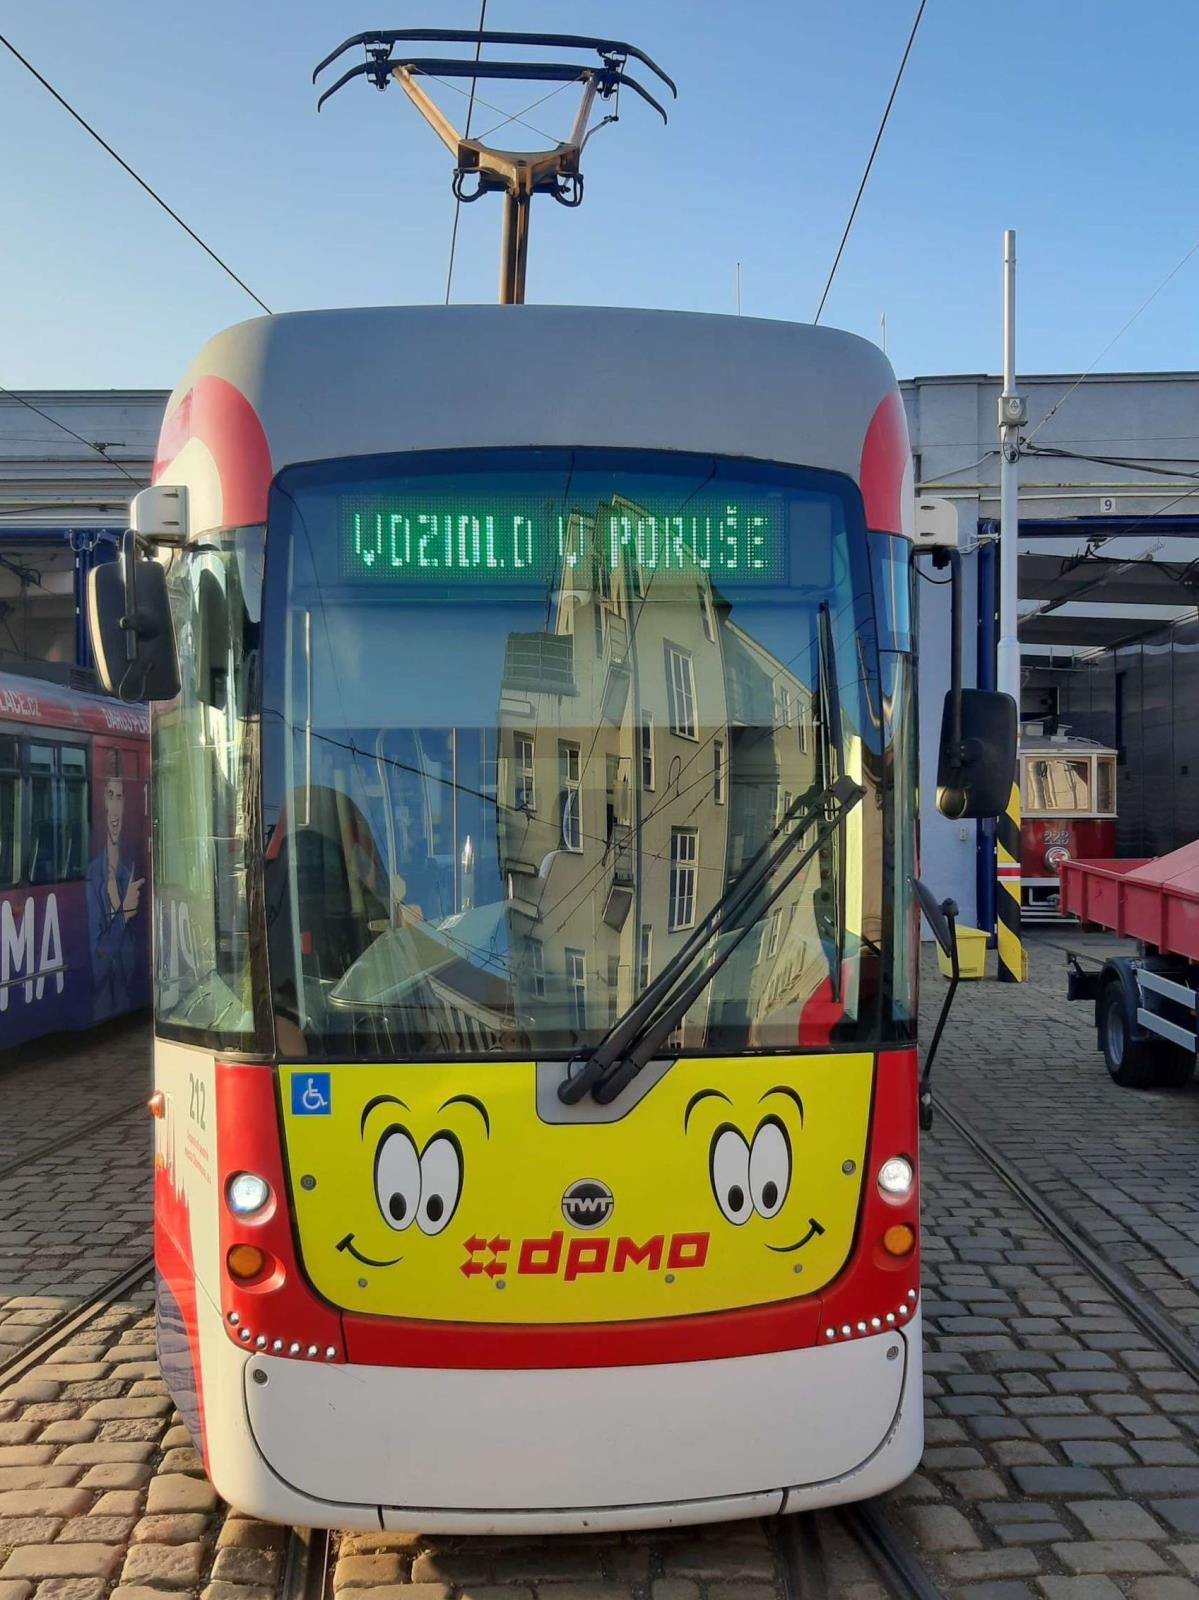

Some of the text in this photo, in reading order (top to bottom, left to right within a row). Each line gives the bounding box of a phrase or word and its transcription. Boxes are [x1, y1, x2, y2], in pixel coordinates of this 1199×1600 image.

[1104, 500, 1113, 511] 9
[354, 513, 533, 567] VOZIDLO
[189, 1072, 206, 1131] 212
[562, 1197, 614, 1212] TWT
